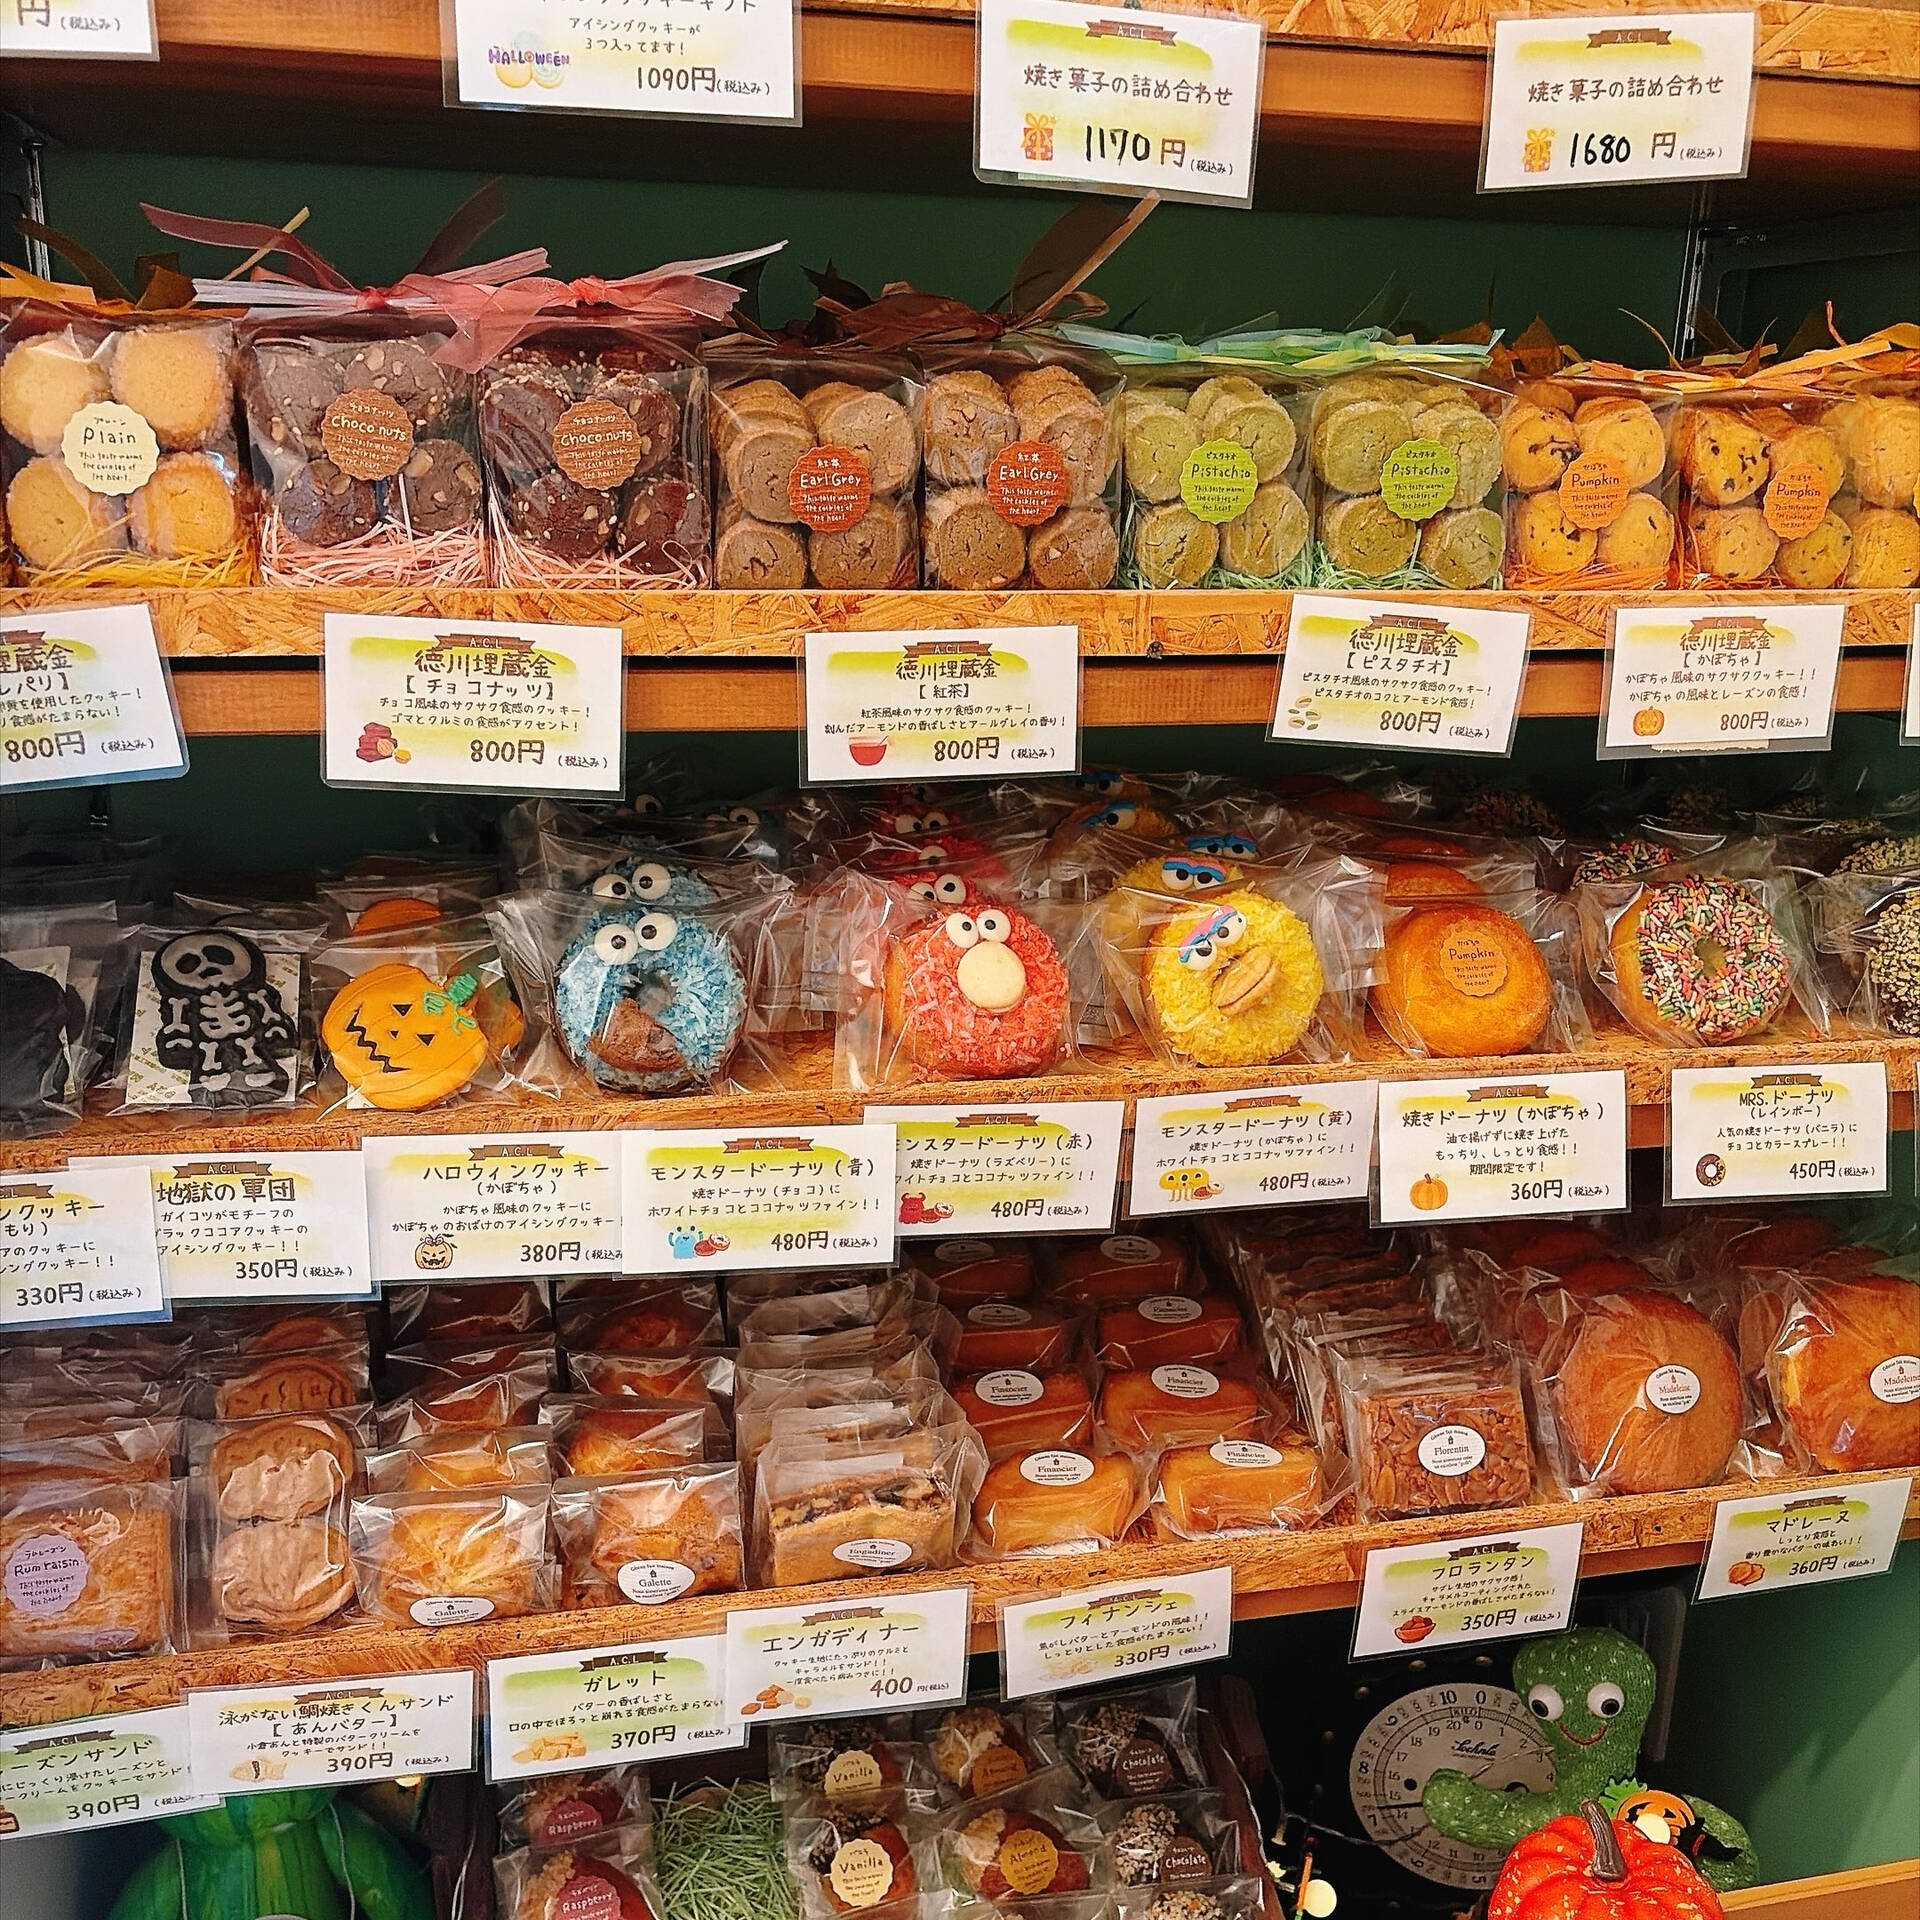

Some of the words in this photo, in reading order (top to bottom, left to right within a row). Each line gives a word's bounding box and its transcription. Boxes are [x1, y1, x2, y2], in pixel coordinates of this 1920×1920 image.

[569, 17, 702, 35] アイシングクッキーが
[488, 47, 571, 67] HALLOWEEN
[585, 37, 685, 56] 3つ入ってます！
[637, 67, 717, 92] 1090円
[1024, 63, 1233, 106] 焼き菓子の詰め合わせ
[1528, 74, 1725, 104] 焼き菓子の詰め合わせ
[1085, 125, 1151, 167] 1170
[1160, 137, 1186, 168] 円
[1570, 132, 1631, 168] 1680
[1651, 131, 1677, 159] 円
[83, 427, 137, 446] Plain
[331, 416, 375, 433] Choco
[379, 425, 407, 442] nuts
[560, 432, 602, 447] Choco
[606, 430, 633, 444] nuts
[1191, 463, 1251, 479] Pistachio
[1391, 463, 1450, 478] Pistachio
[1571, 473, 1620, 488] Pumpkin
[1776, 485, 1821, 499] Pumpkin
[1349, 628, 1464, 658] 徳川埋蔵金
[1680, 630, 1775, 651] 徳川埋蔵金
[414, 650, 556, 679] 徳川埋蔵金
[896, 658, 1000, 681] 徳川埋蔵金
[1683, 650, 1762, 668] 【かぼちゃ】
[919, 683, 970, 700] 【紅茶】
[1380, 710, 1441, 734] 800円
[1720, 710, 1769, 731] 800円
[4, 730, 86, 763] 800円
[470, 739, 545, 764] 800円
[934, 736, 1000, 761] 800円
[1449, 948, 1495, 961] Pumpkin
[423, 1160, 609, 1180] ハロウィンクッキー
[1470, 1162, 1544, 1175] 期間限定です！
[1789, 1160, 1836, 1179] 450円
[156, 1178, 296, 1205] 地獄の軍団
[1259, 1173, 1309, 1191] 480円
[1510, 1179, 1563, 1201] 360円
[161, 1208, 294, 1222] ガイコツがモチーフの
[443, 1201, 591, 1215] かぼちゃ風味のクッキーに
[991, 1199, 1044, 1218] 480円
[771, 1230, 829, 1251] 480円
[520, 1241, 581, 1263] 380円
[235, 1258, 298, 1279] 350円
[16, 1282, 83, 1307] 330円
[1434, 1446, 1469, 1455] Florentin
[1038, 1464, 1077, 1474] Financier
[1766, 1510, 1850, 1533] マドレーヌ
[15, 1562, 41, 1576] Rum
[43, 1557, 81, 1572] raisin
[1432, 1556, 1535, 1580] フロランタン
[1789, 1556, 1838, 1576] 360円
[639, 1577, 672, 1588] Galette
[1060, 1600, 1178, 1629] フィナンシェ
[1461, 1609, 1517, 1631] 350円
[762, 1623, 920, 1653] エンガディナー
[1114, 1645, 1170, 1667] 330円
[584, 1670, 666, 1692] ガレット
[870, 1677, 913, 1698] 400
[1440, 1689, 1458, 1705] 10
[611, 1725, 675, 1749] 370円
[327, 1752, 393, 1773] 390円
[1122, 1754, 1165, 1772] Chocolate
[833, 1767, 874, 1783] Vanilla
[67, 1794, 139, 1819] 390円
[549, 1818, 598, 1836] Raspberry
[839, 1856, 884, 1874] Vanilla
[1165, 1854, 1207, 1868] Chocolate
[562, 1893, 614, 1912] Raspberry
